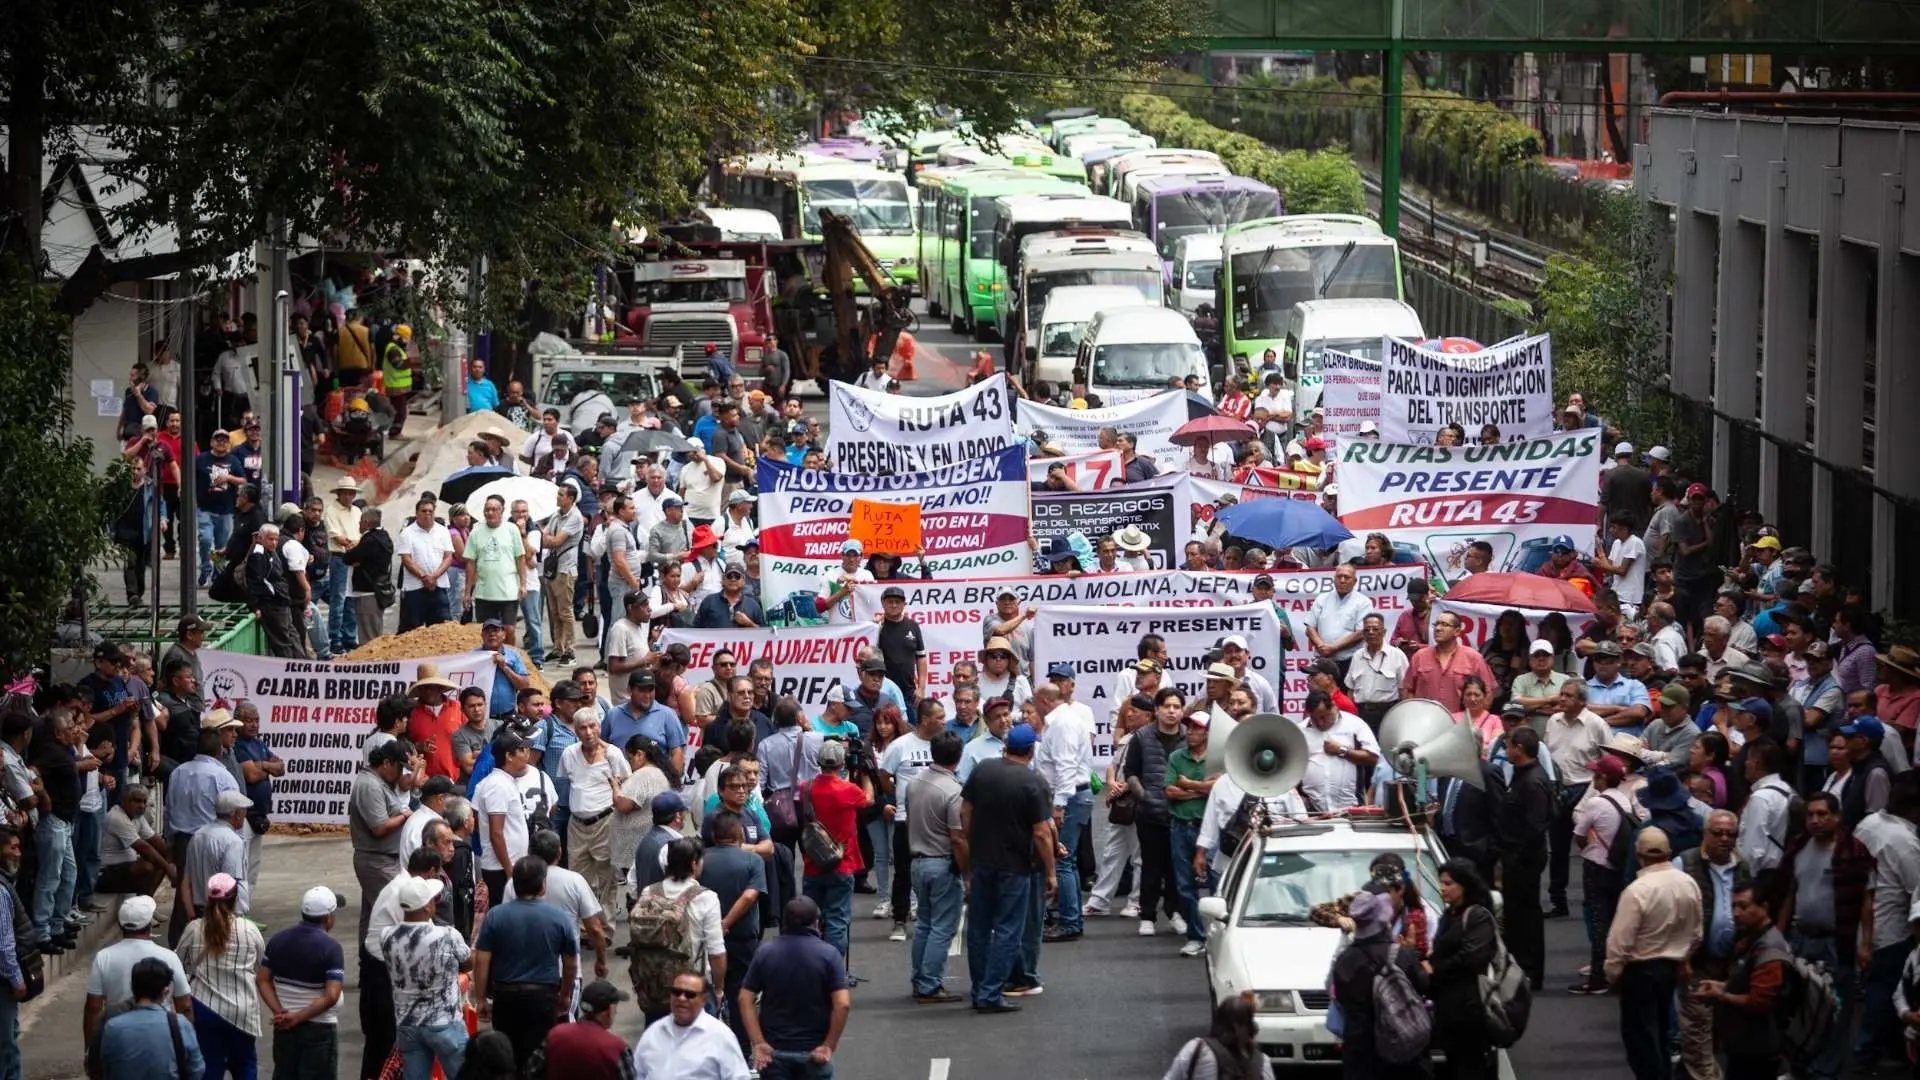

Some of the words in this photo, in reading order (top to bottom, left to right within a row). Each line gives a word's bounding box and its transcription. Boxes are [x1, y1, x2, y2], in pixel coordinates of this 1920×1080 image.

[1323, 353, 1346, 369] CLARA
[1391, 342, 1416, 366] POR
[1420, 352, 1448, 371] UNA
[1452, 354, 1498, 374] TARIFA
[1501, 341, 1543, 370] JUSTA
[1387, 369, 1421, 395] PARA
[1425, 374, 1441, 397] LA
[1446, 369, 1546, 398] DIGNIFICACION
[898, 400, 967, 432] RUTA
[972, 387, 1002, 422] 43
[1408, 399, 1433, 424] DEL
[1437, 399, 1526, 425] TRANSPORTE
[837, 441, 917, 473] PRESENTE
[915, 443, 930, 471] Y
[933, 442, 952, 468] EN
[958, 434, 1006, 462] APOYO
[1342, 441, 1453, 464] RUTAS
[1463, 434, 1597, 463] UNIDAS
[834, 469, 918, 492] COSTOS
[1378, 466, 1563, 493] PRESENTE
[790, 496, 843, 514] PERO
[948, 486, 992, 507] NO!!
[1035, 504, 1063, 517] DE
[1069, 498, 1165, 516] REZAGOS
[948, 514, 970, 529] EN
[971, 514, 989, 528] LA
[1051, 519, 1071, 527] DEL
[1073, 514, 1143, 526] TRANSPORTE
[1388, 500, 1484, 527] RUTA
[1490, 501, 1546, 524] 43
[872, 523, 894, 536] 73
[1095, 525, 1109, 534] DE
[863, 538, 911, 551] APOYA
[924, 536, 935, 549] Y
[936, 534, 986, 549] DIGNA!
[772, 561, 818, 576] PARA
[899, 549, 1019, 574] RABAJANDO.
[964, 583, 1077, 604] BRGADA
[1185, 576, 1239, 595] JEFA
[1053, 621, 1110, 637] RUTA
[1116, 620, 1142, 634] 47
[1149, 616, 1263, 634] PRESENTE
[761, 635, 870, 667] AUMENTO
[256, 677, 320, 700] CLARA
[324, 678, 416, 700] BRUGAD
[271, 705, 308, 724] RUTA
[311, 707, 321, 723] 4
[287, 758, 352, 775] GOBIERNO
[272, 779, 352, 795] HOMOLOGAR
[277, 799, 327, 815] ESTADO
[328, 800, 345, 815] DE
